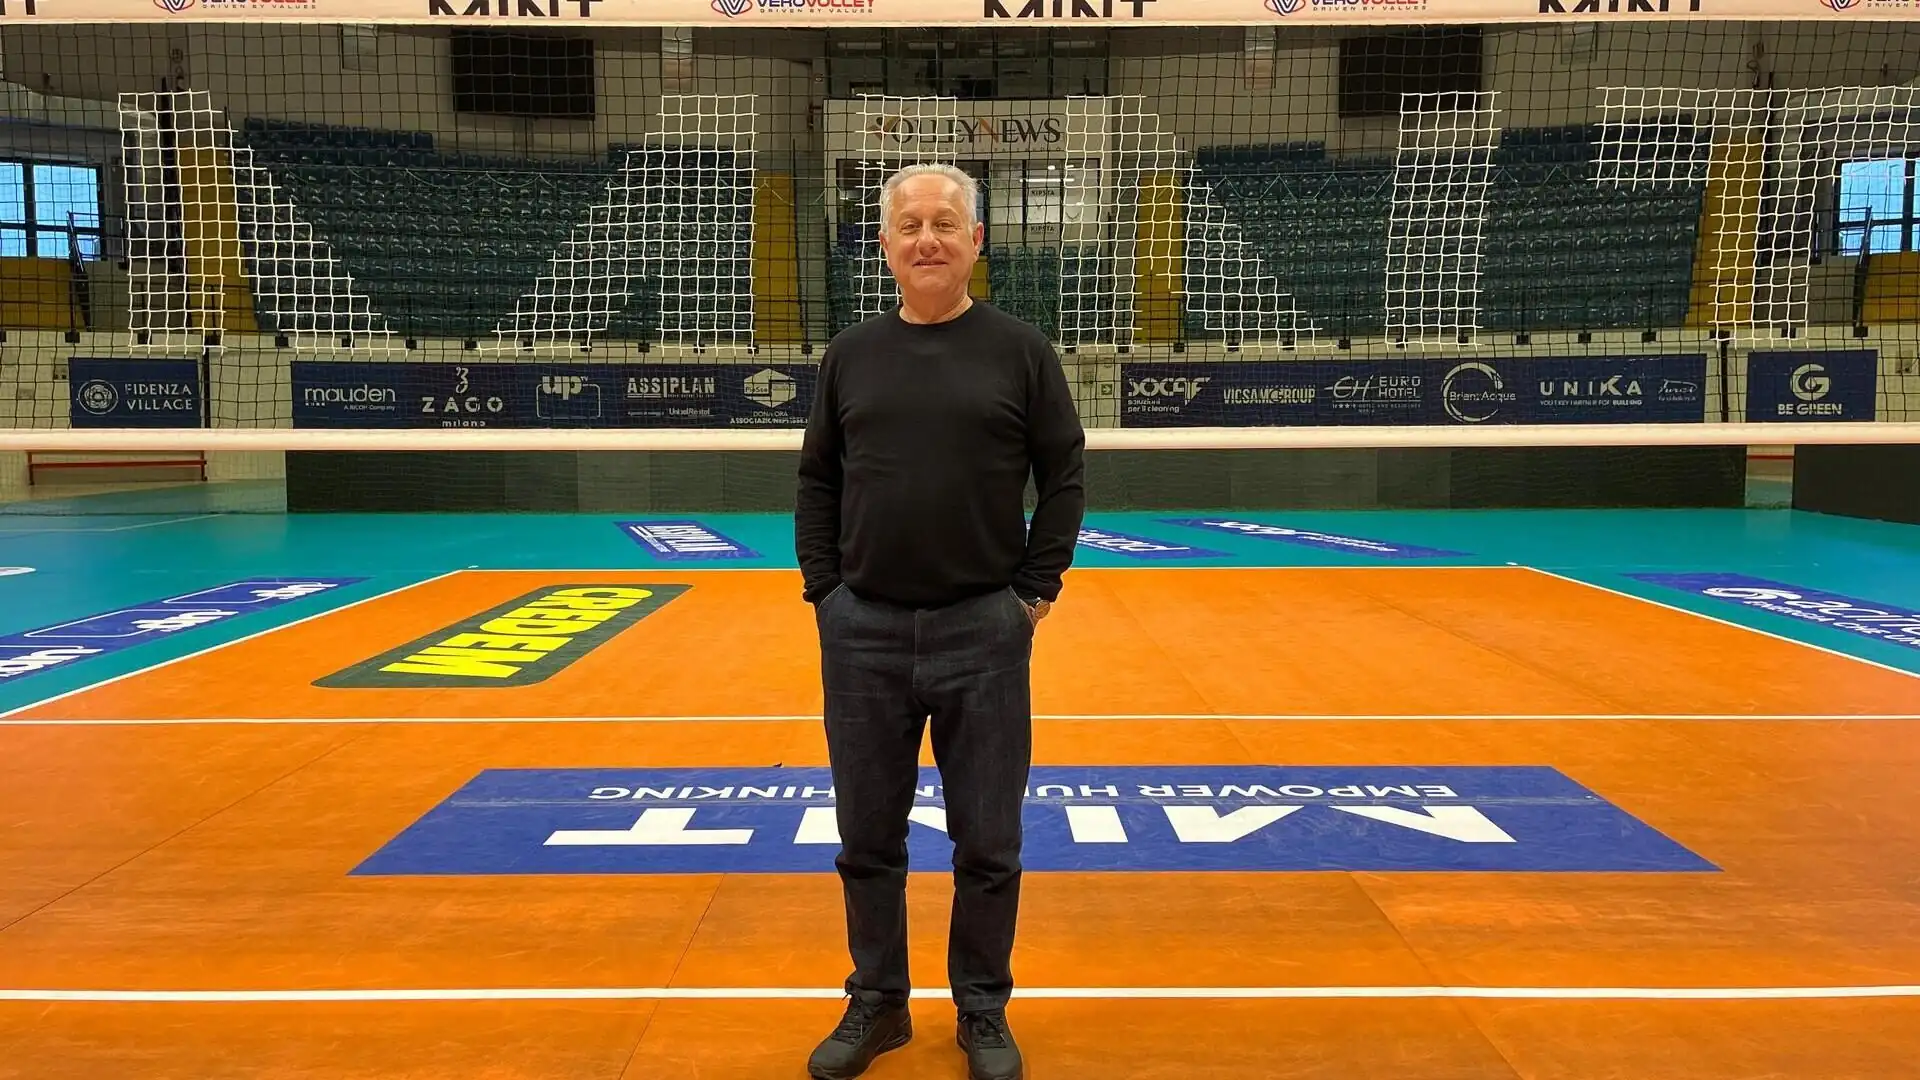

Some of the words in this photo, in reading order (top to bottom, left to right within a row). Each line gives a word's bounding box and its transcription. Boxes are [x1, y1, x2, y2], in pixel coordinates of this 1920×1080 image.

[125, 383, 192, 395] FIDENZA
[627, 377, 715, 397] ASSIPLAN
[1379, 376, 1421, 387] EURO
[1540, 375, 1643, 396] UNIKA
[304, 384, 397, 402] mauden
[126, 398, 193, 410] VILLAGE
[422, 396, 503, 413] ZAGO
[1777, 403, 1793, 415] BE
[1796, 403, 1843, 415] GREEN
[378, 587, 653, 678] CREDEM
[588, 785, 836, 799] HINKING
[1137, 784, 1459, 798] EMPOWER
[543, 805, 1517, 846] MIT
